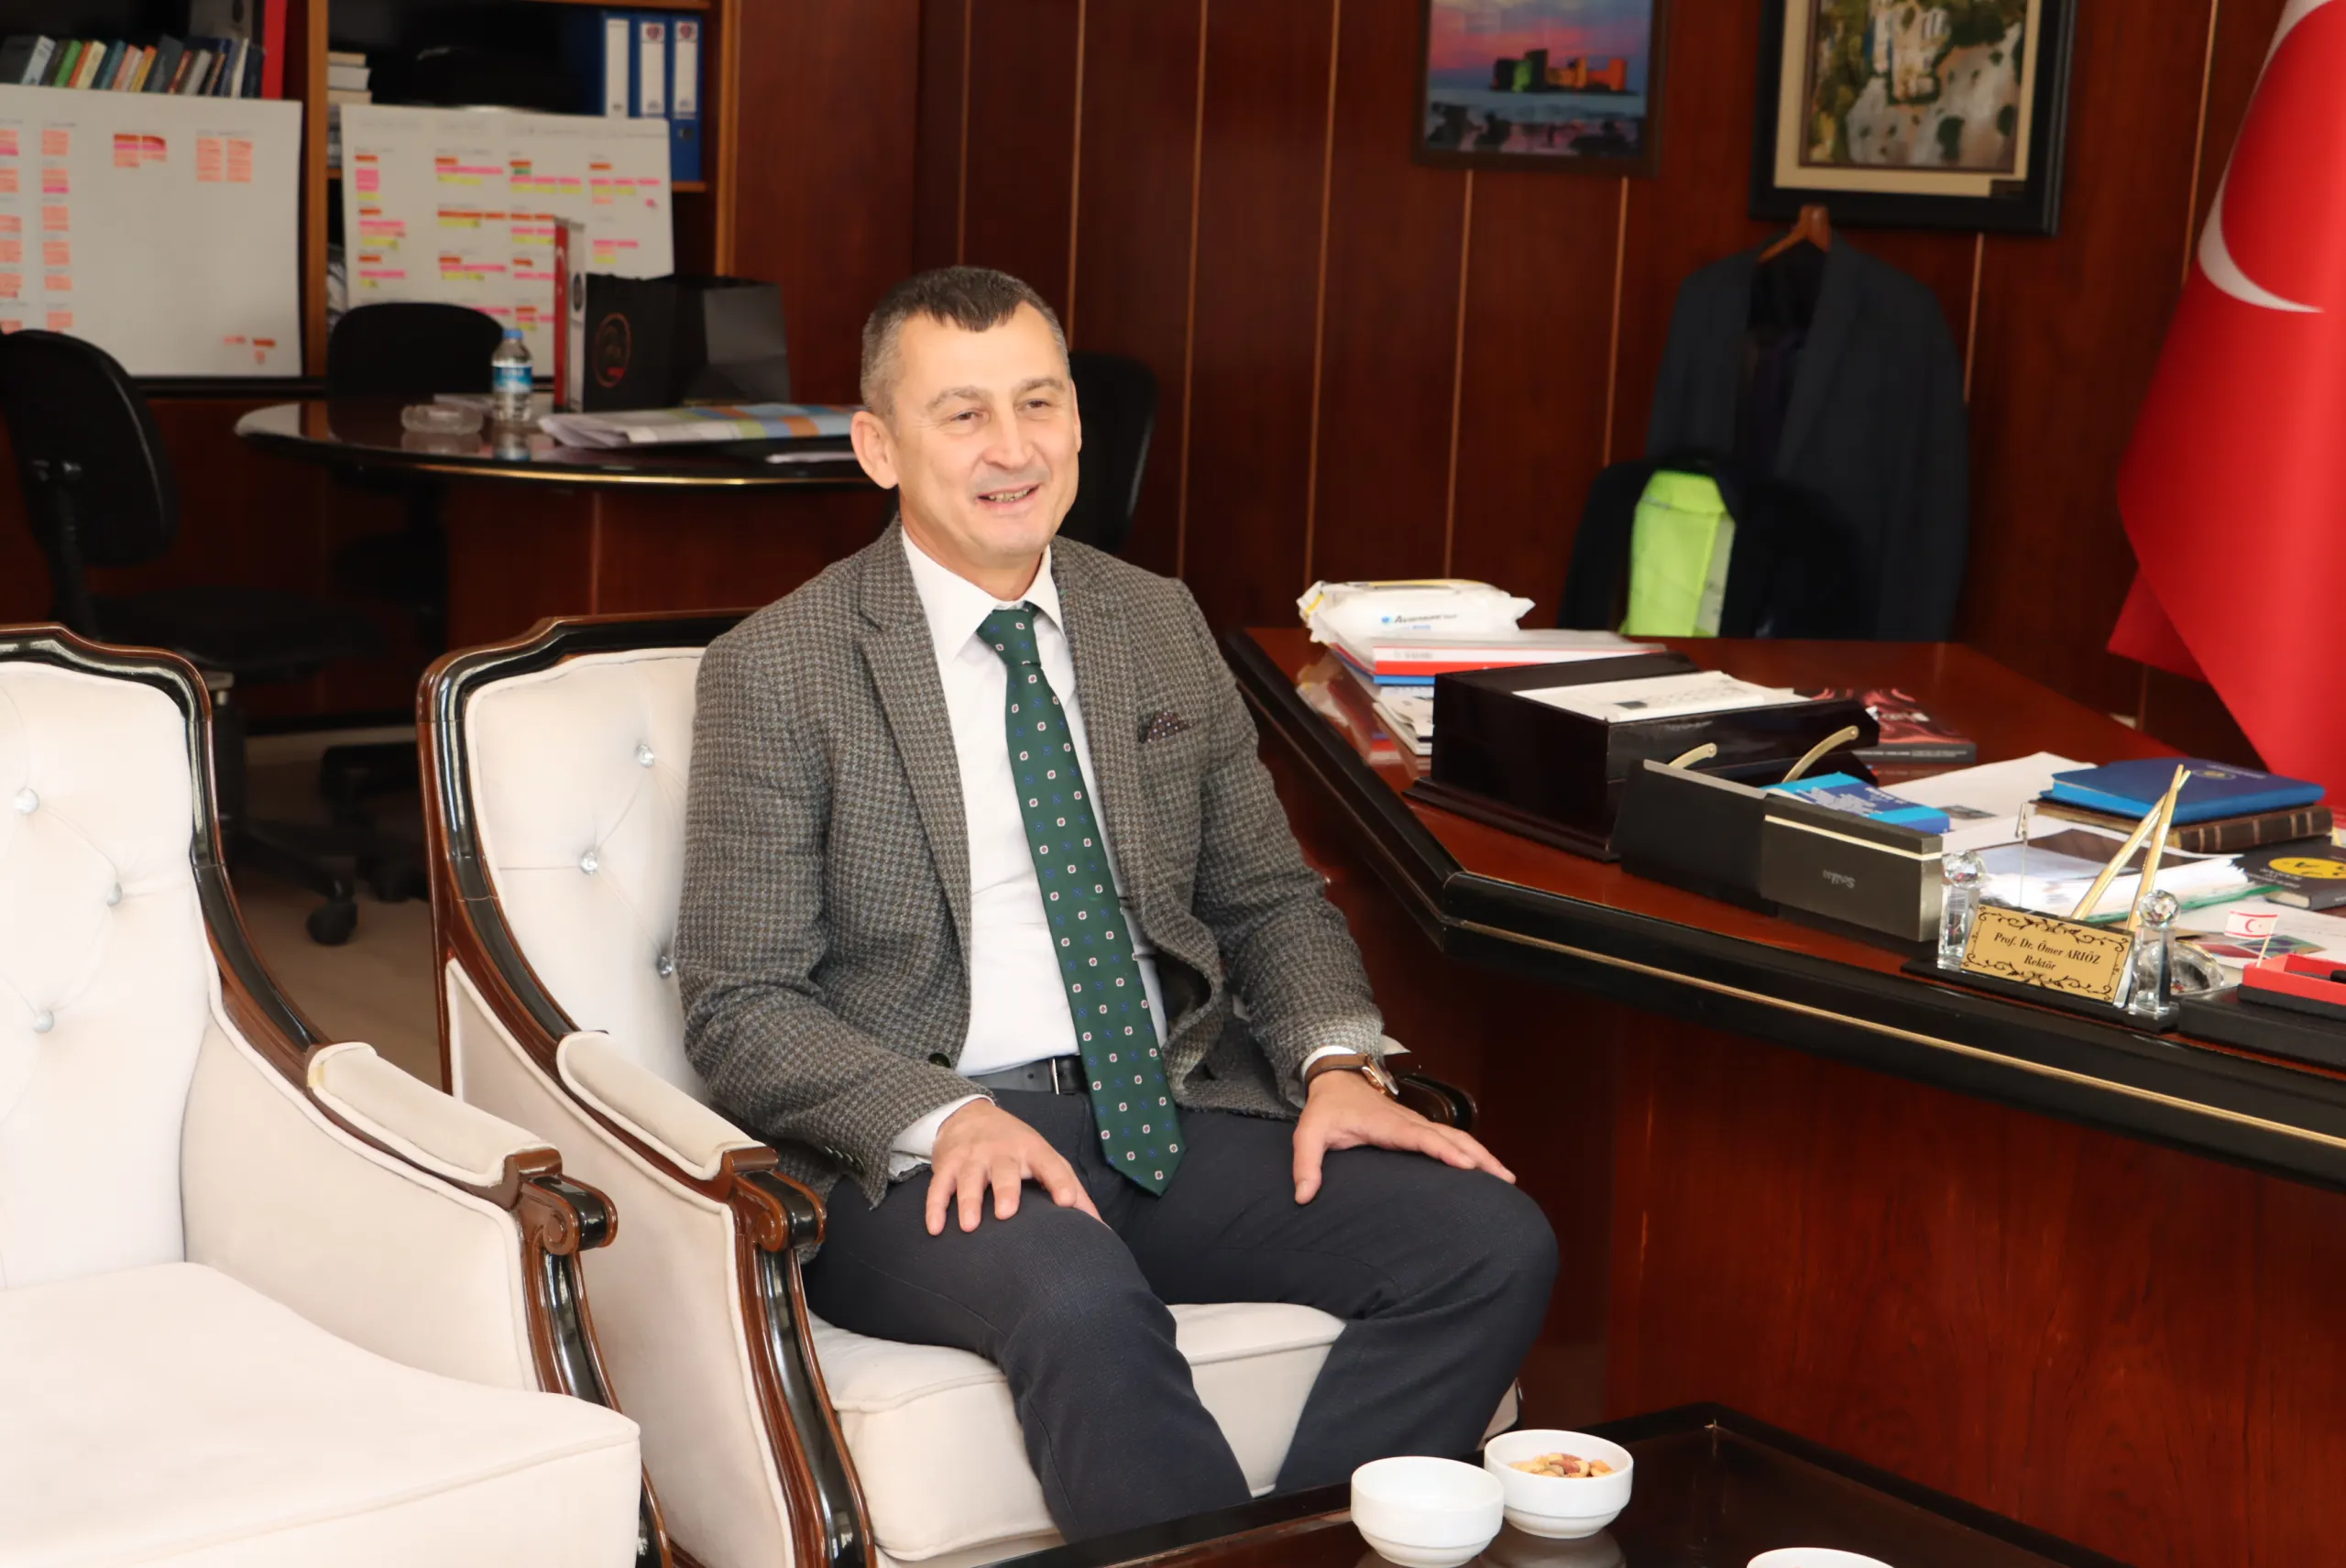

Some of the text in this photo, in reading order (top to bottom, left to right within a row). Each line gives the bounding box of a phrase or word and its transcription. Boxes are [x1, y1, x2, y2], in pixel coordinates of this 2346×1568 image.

[1993, 931, 2101, 965] Prof. Dr. Ömer ARIÖZ
[2023, 954, 2056, 970] Rektör
